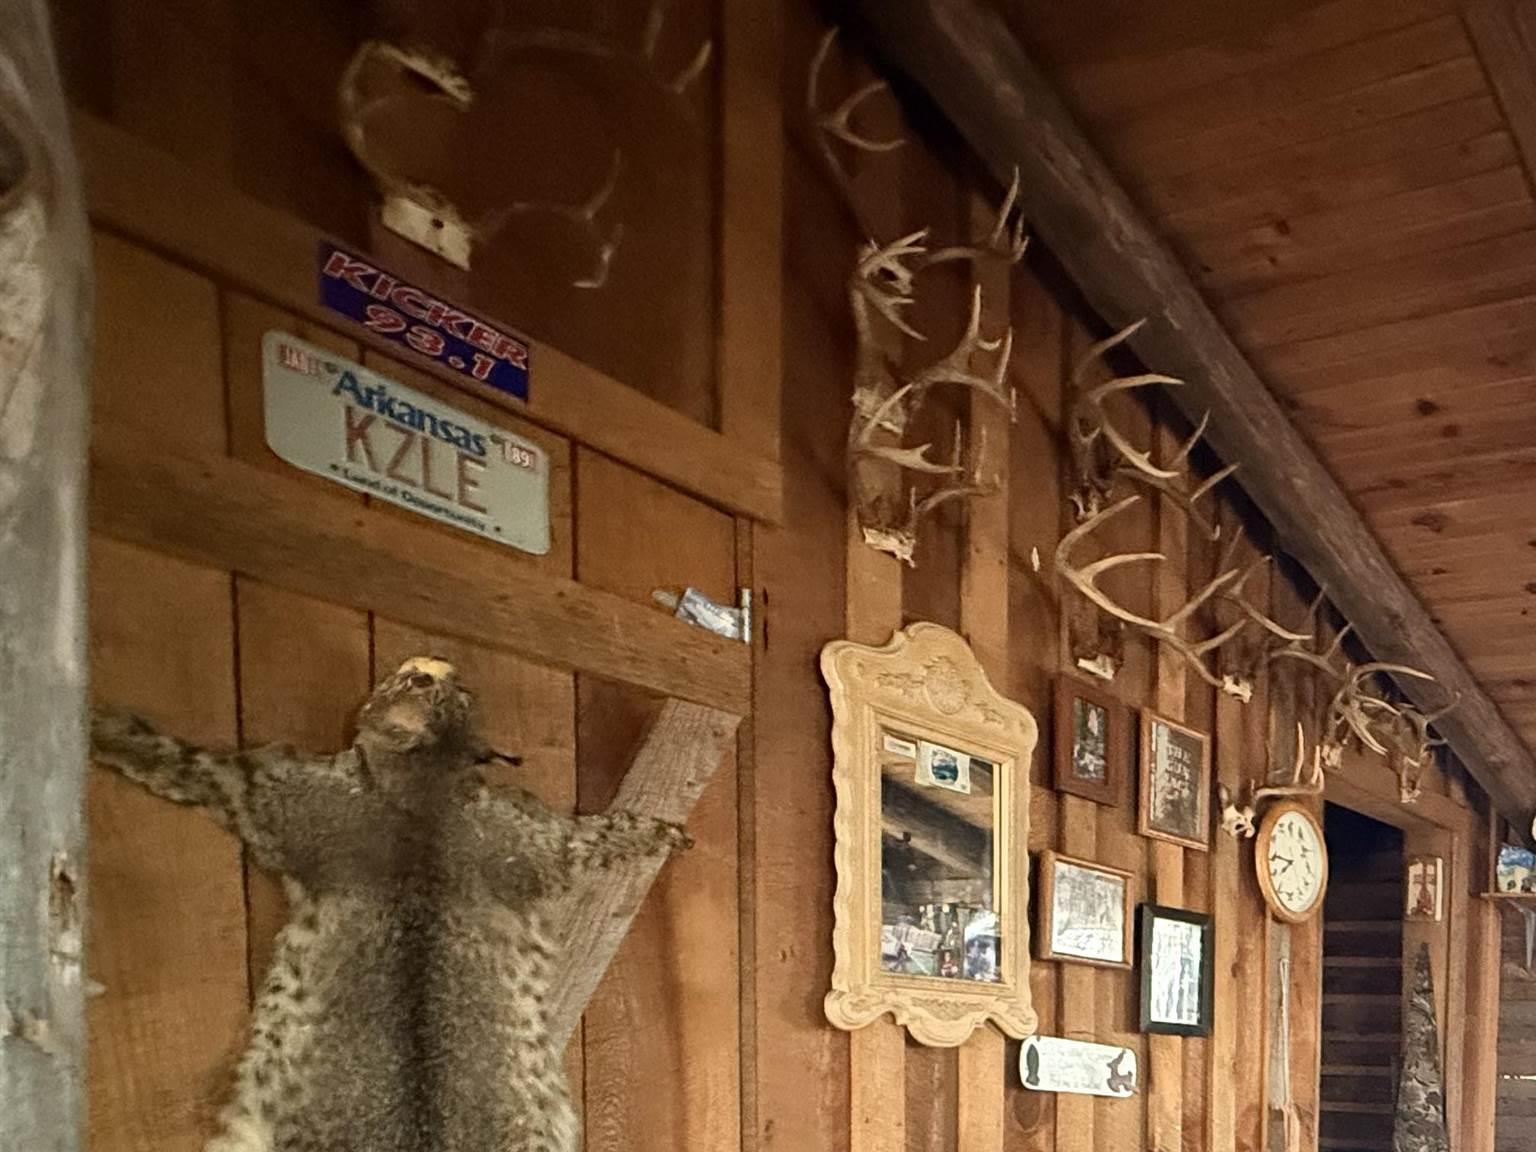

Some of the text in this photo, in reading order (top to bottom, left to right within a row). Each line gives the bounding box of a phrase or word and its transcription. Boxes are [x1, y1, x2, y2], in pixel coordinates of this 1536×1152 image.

[323, 251, 528, 371] KICKER
[364, 303, 496, 381] 93.1
[332, 371, 487, 457] Arkansas
[345, 405, 488, 515] KZLE
